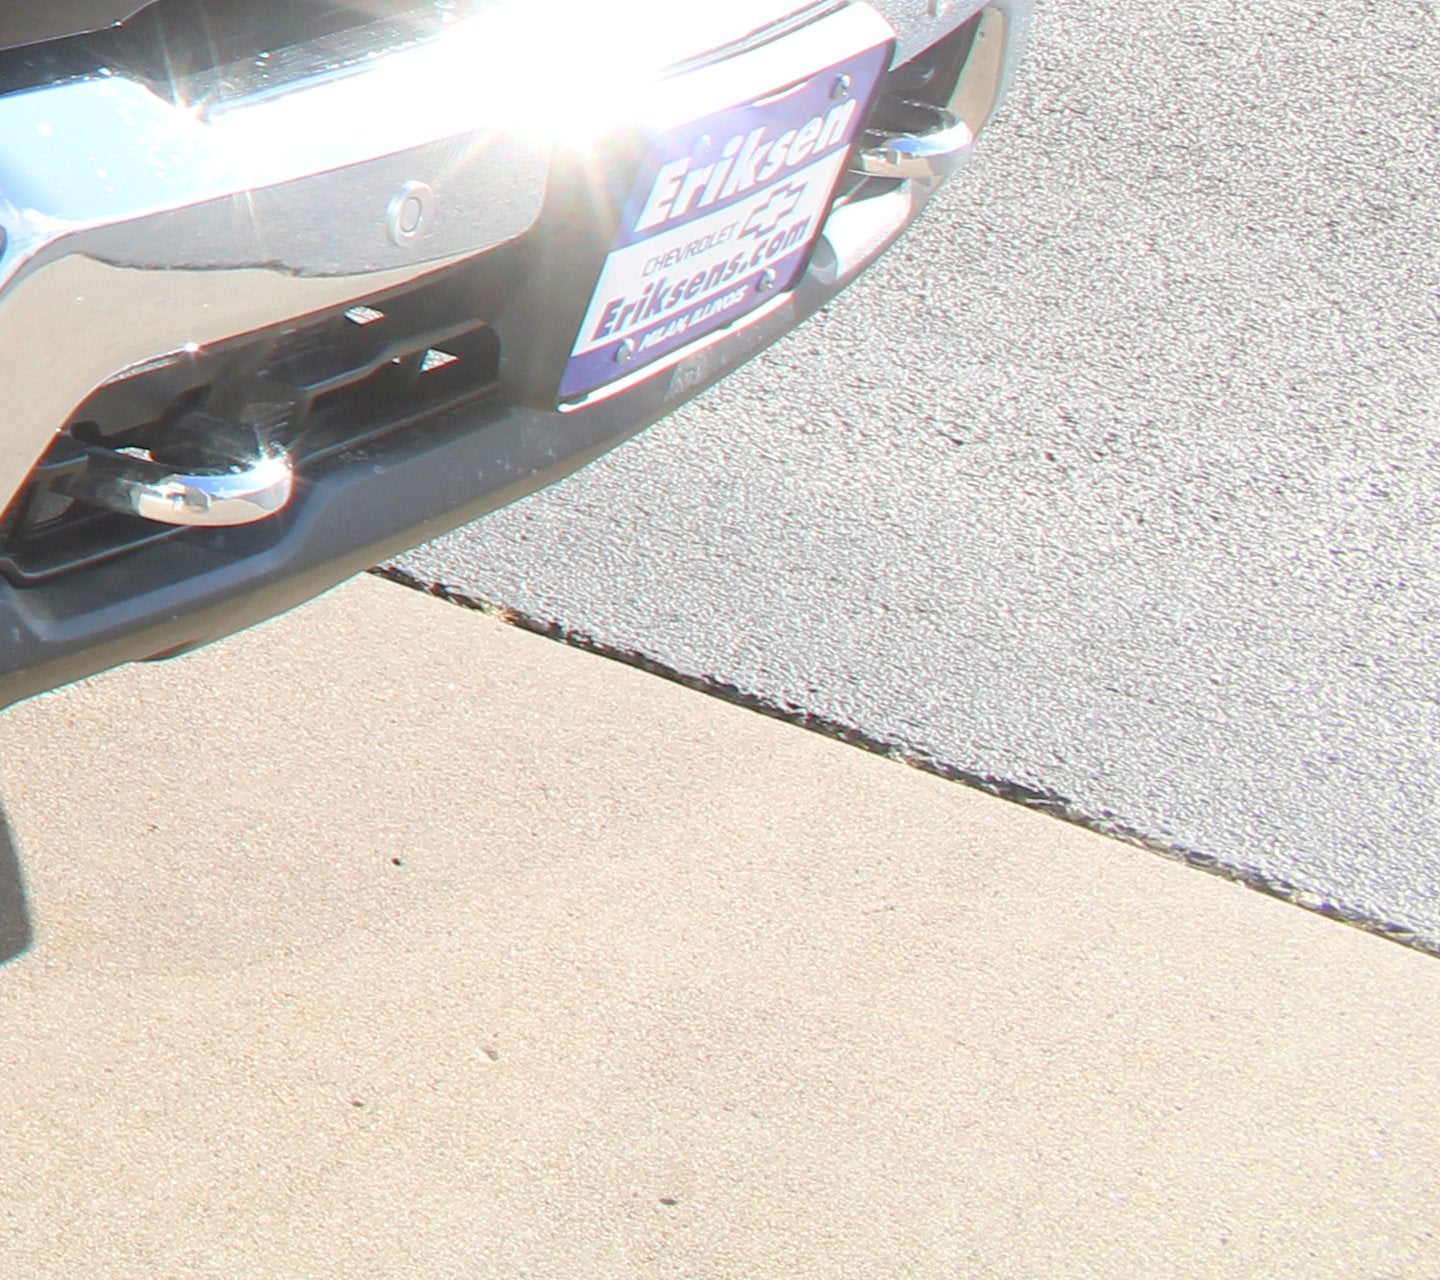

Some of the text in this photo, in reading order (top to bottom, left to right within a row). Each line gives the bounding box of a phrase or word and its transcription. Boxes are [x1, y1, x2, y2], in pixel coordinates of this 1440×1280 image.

[633, 99, 857, 233] Eriksen
[591, 216, 811, 341] Eriksens.com
[642, 220, 738, 278] CHEVROLET
